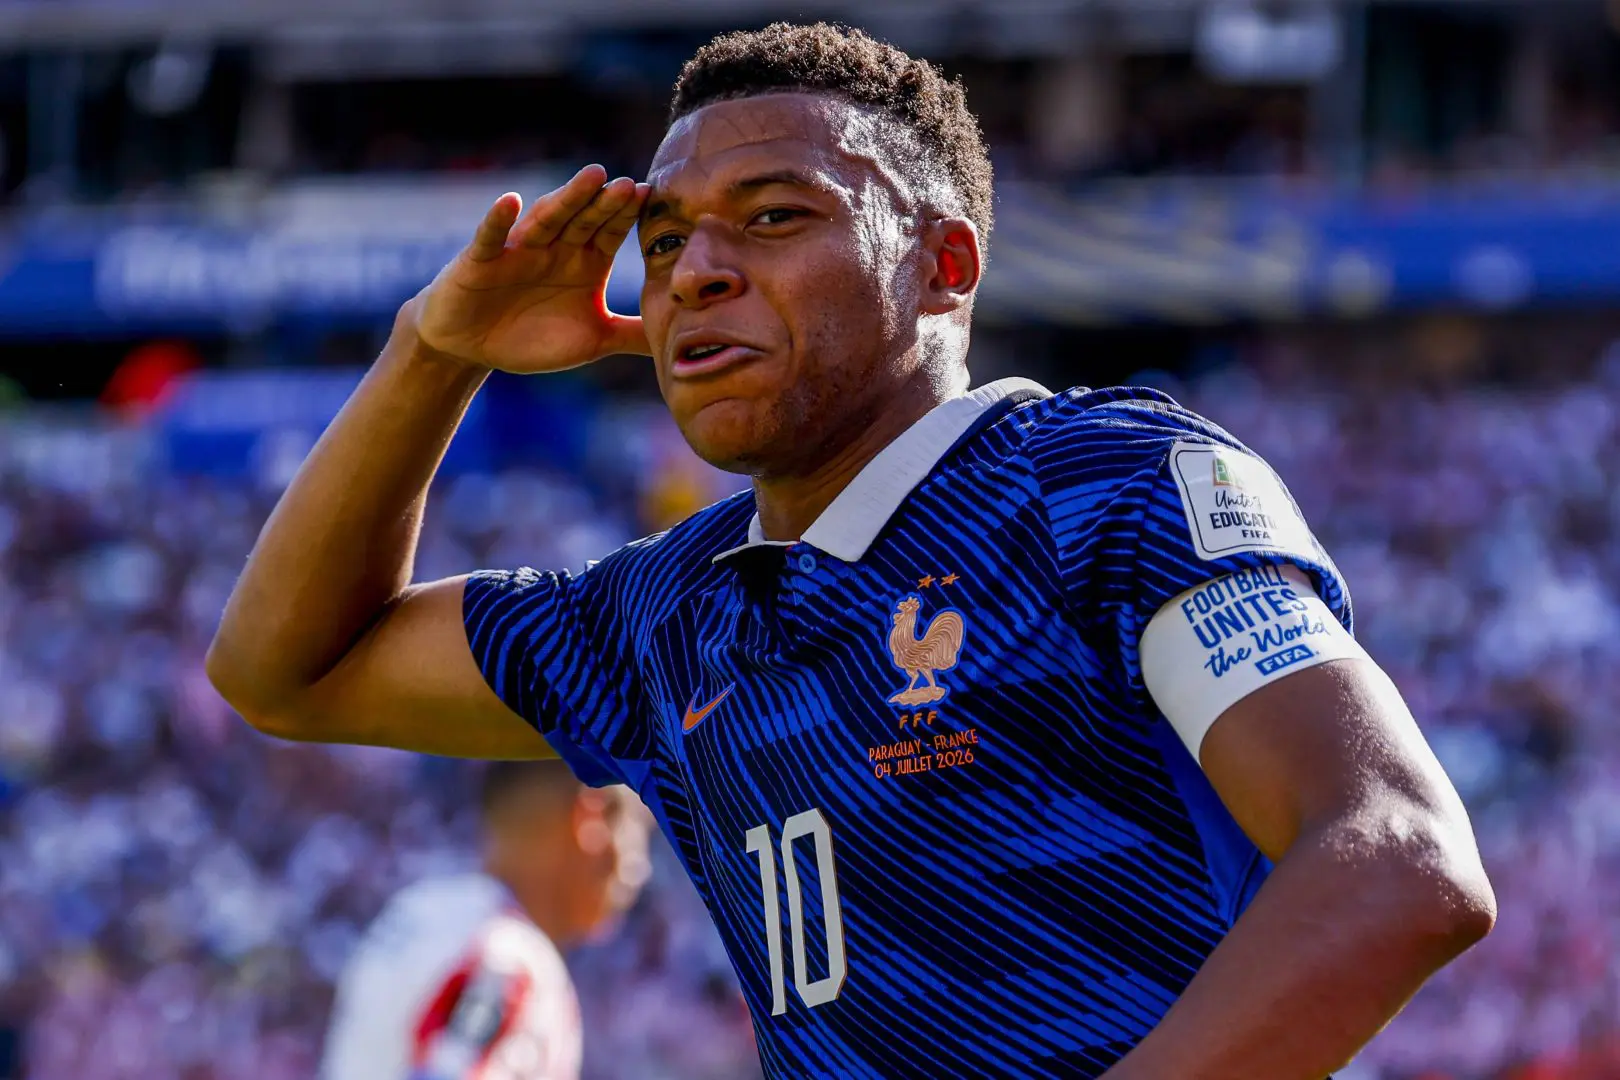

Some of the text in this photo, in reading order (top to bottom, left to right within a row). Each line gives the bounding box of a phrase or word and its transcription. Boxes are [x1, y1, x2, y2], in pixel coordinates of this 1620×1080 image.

[1241, 529, 1272, 539] FIFA
[1181, 563, 1290, 624] FOOTBALL
[1193, 588, 1309, 649] UNITES
[1204, 614, 1331, 678] the World
[1260, 647, 1309, 673] FIFA
[868, 738, 921, 762] PARAGUAY
[933, 728, 978, 750] FRANCE
[874, 748, 974, 778] 04 JUILLET 2026
[745, 807, 848, 1016] 10
